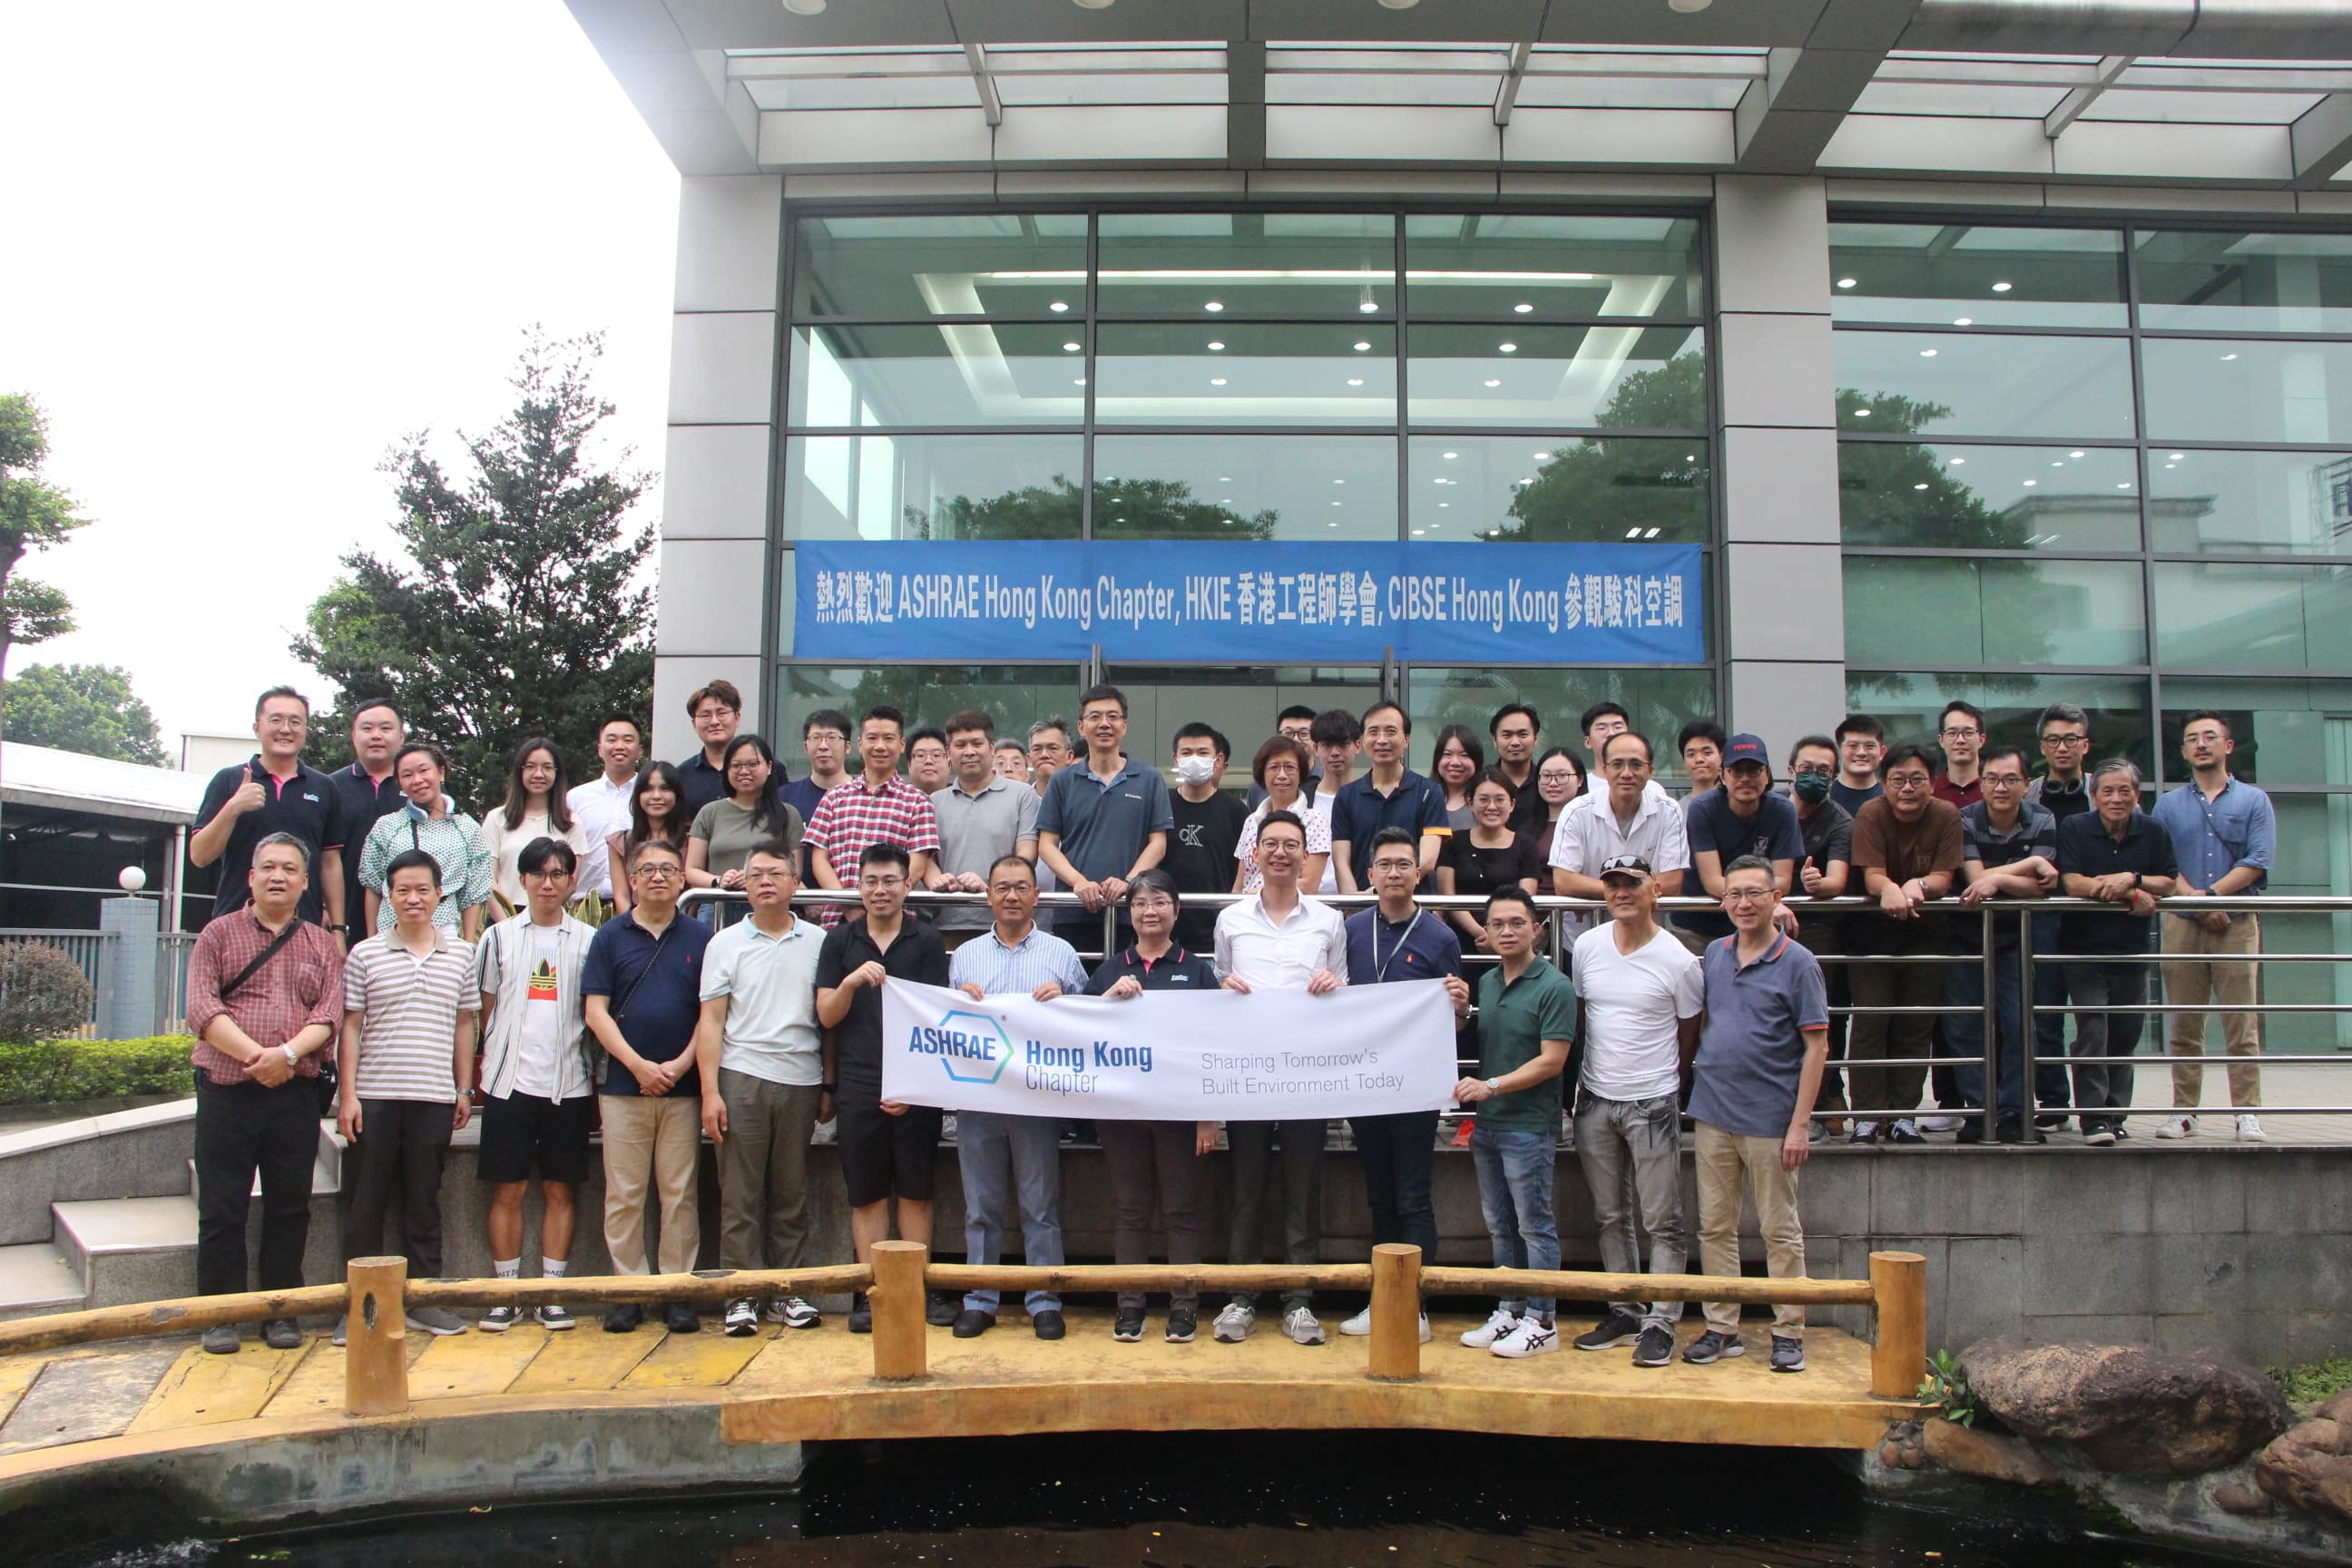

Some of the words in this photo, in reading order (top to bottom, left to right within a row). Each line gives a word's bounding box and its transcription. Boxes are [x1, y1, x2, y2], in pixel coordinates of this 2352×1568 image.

[817, 570, 893, 624] 熱烈歡迎
[897, 574, 979, 619] ASHRAE
[985, 574, 1036, 629] Hong
[1041, 575, 1092, 631] Kong
[1096, 575, 1181, 631] Chapter,
[1185, 575, 1231, 621] HKIE
[1237, 571, 1384, 627] 香港工程師學會,
[1388, 575, 1446, 622] CIBSE
[1452, 577, 1504, 633] Hong
[1509, 578, 1559, 633] Kong
[1565, 573, 1683, 629] 參觀駿科空調
[908, 1025, 995, 1061] ASHRAE
[1026, 1040, 1084, 1073] Hong
[1094, 1041, 1152, 1073] Kong
[1200, 1052, 1275, 1073] Sharping
[1281, 1047, 1378, 1068] Tomorrow's
[1026, 1064, 1099, 1096] Chapter
[1202, 1077, 1240, 1094] Built
[1245, 1074, 1349, 1093] Environment
[1355, 1073, 1405, 1092] Today
